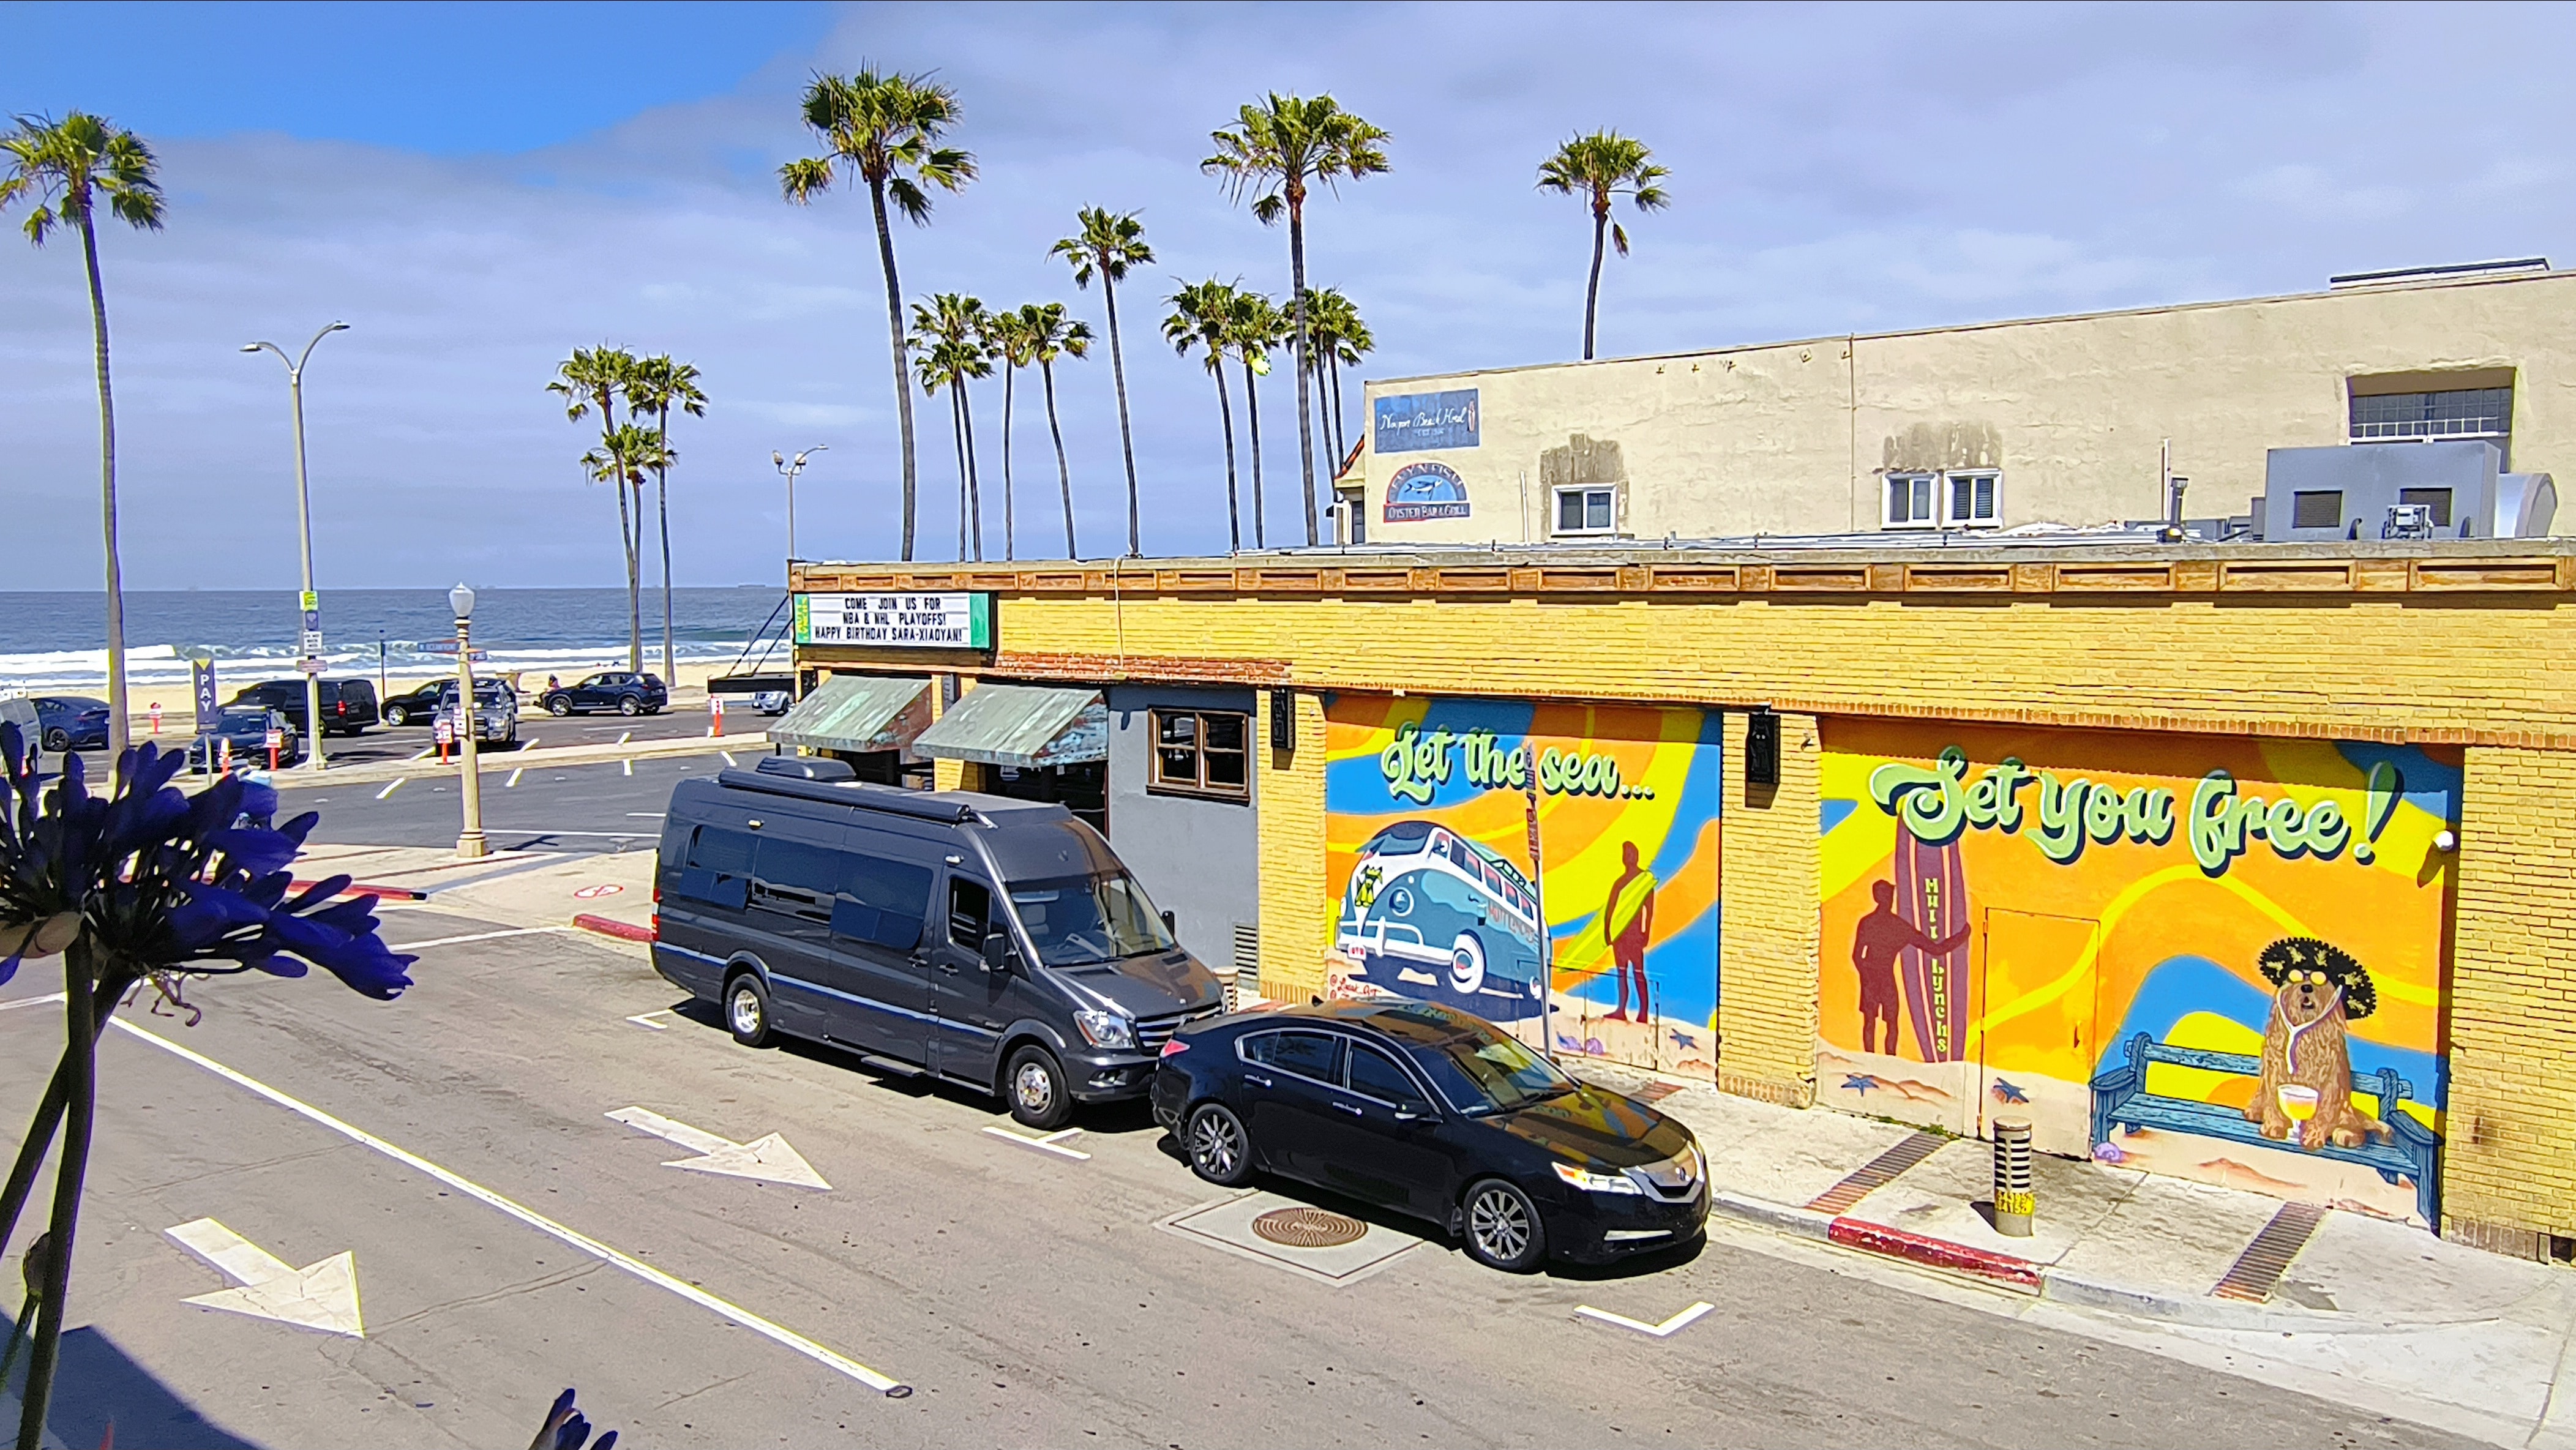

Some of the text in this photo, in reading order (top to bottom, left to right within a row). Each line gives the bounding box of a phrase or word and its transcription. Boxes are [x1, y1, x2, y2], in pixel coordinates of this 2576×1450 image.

[1388, 505, 1466, 518] OYSTER BAR & GRILL
[845, 597, 941, 610] COME JOIN US FOR
[843, 612, 946, 626] NBA & NHL PLAYOFFS!
[815, 626, 841, 640] HAPPY
[847, 627, 887, 640] BIRTHDAY
[200, 674, 212, 712] PAY
[1379, 722, 1455, 804] Let
[1459, 728, 1526, 790] the
[1870, 745, 2031, 846] Set
